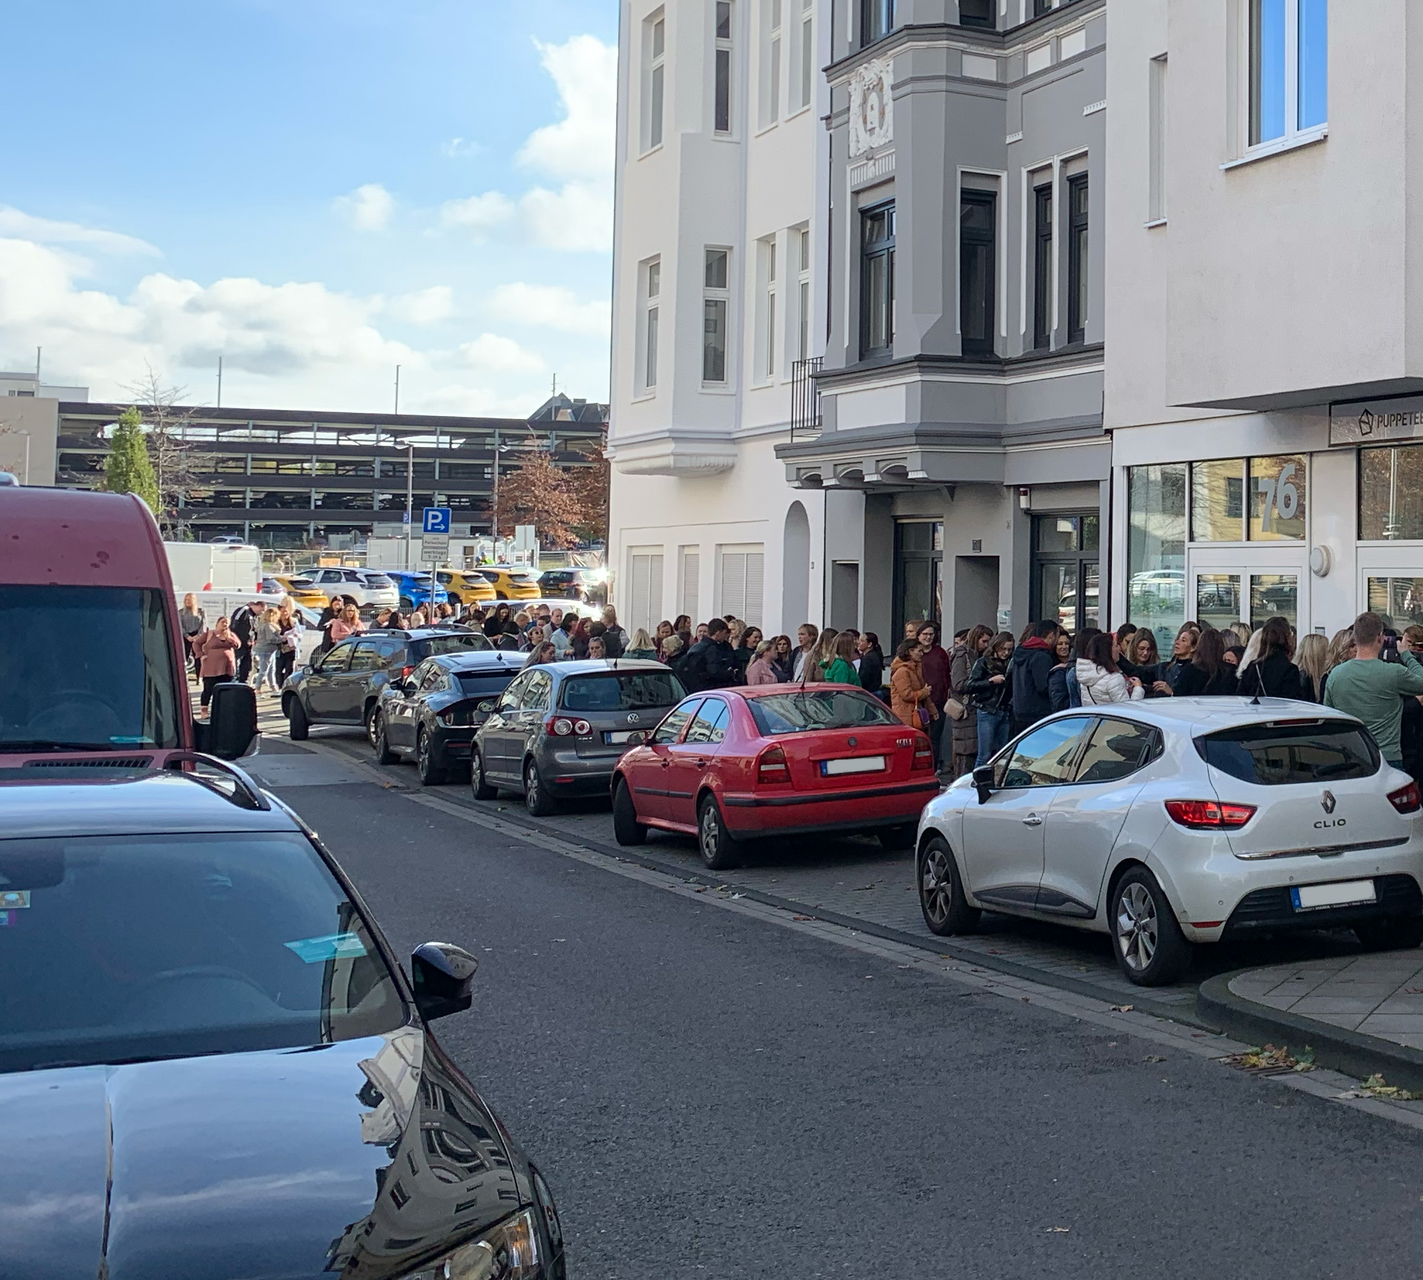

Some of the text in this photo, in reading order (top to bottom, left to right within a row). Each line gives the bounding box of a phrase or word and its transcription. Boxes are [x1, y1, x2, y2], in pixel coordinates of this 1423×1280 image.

[1258, 463, 1298, 532] 76
[427, 511, 443, 530] P
[1313, 818, 1347, 829] CLIO
